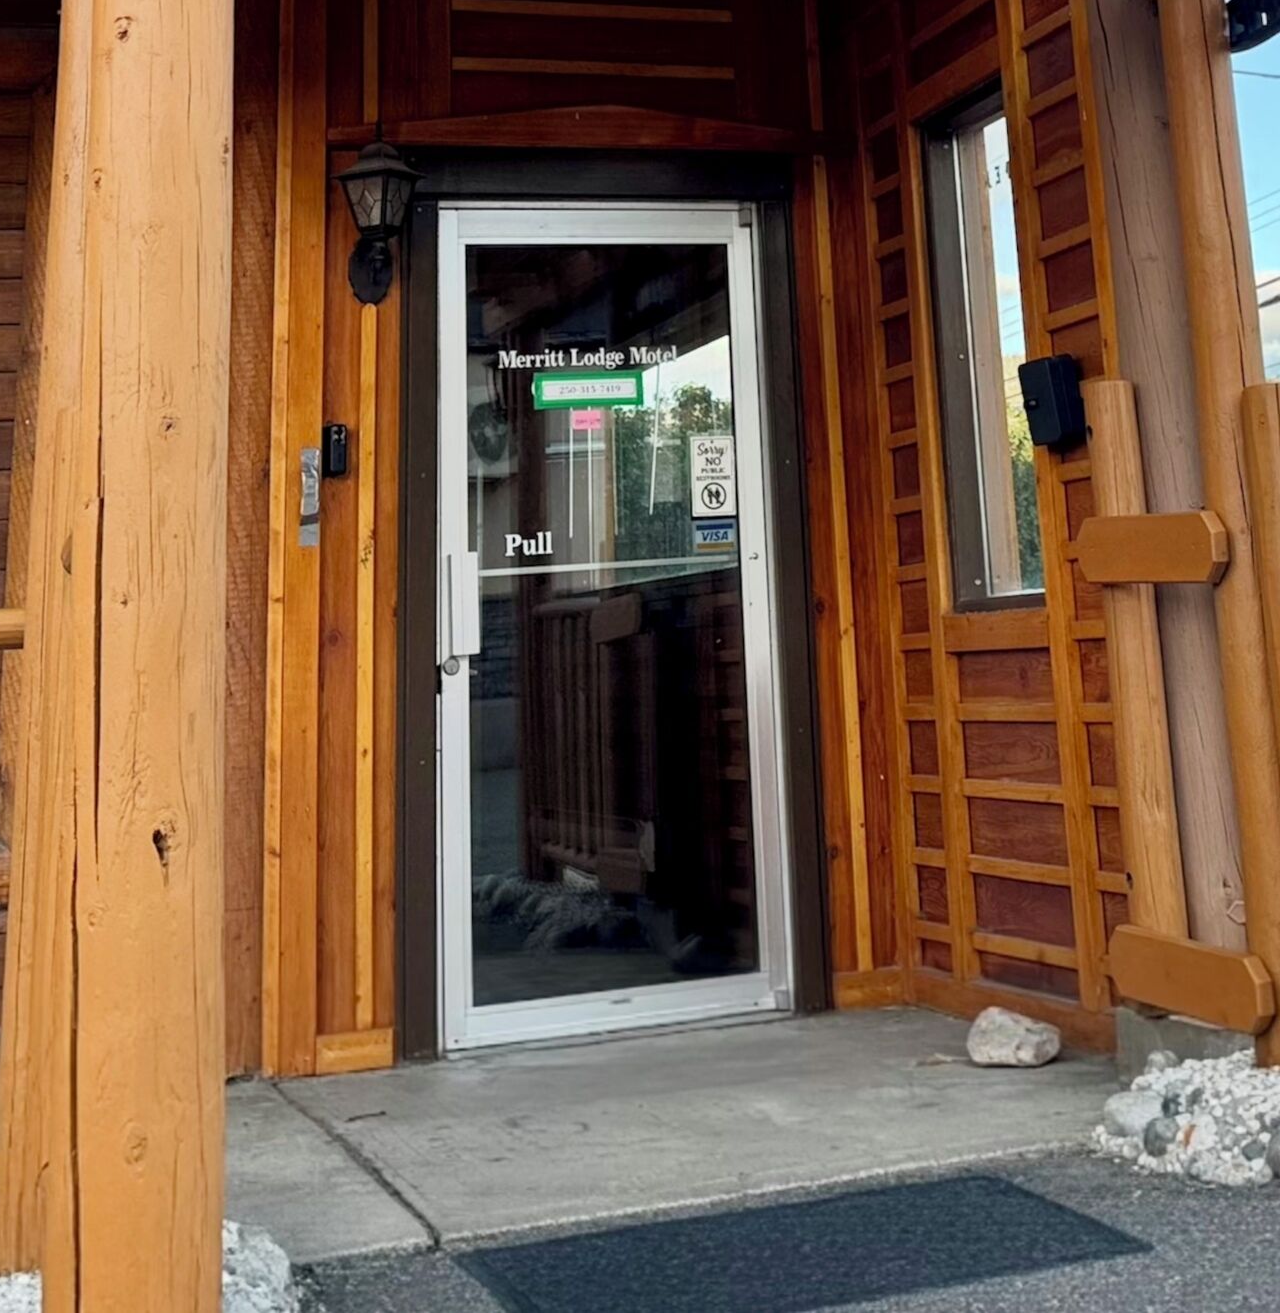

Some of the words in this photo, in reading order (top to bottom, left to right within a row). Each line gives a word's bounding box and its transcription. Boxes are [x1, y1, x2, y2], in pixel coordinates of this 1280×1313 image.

[498, 349, 565, 369] Merritt
[570, 347, 625, 369] Lodge
[629, 345, 678, 366] Motel
[705, 457, 722, 466] NO
[504, 531, 554, 557] Pull
[701, 530, 729, 542] VISA
